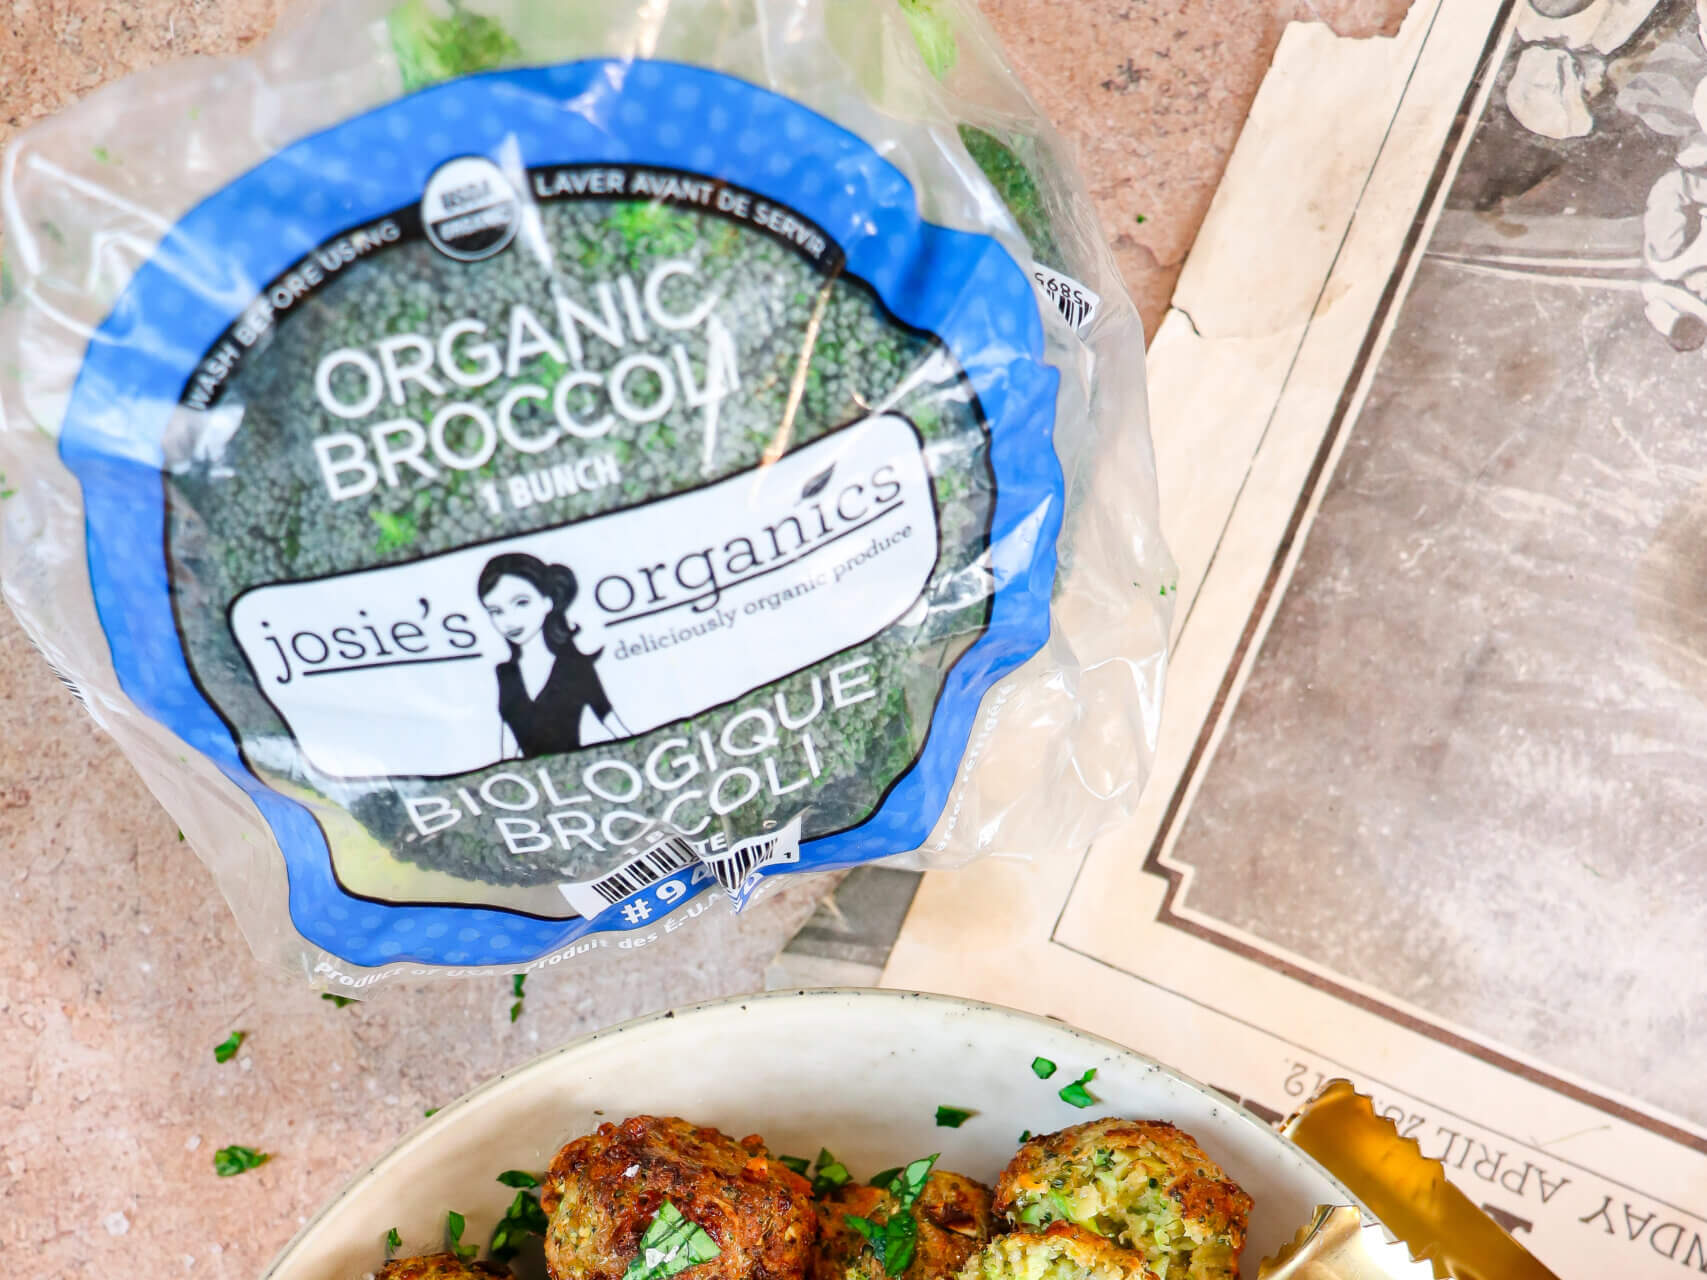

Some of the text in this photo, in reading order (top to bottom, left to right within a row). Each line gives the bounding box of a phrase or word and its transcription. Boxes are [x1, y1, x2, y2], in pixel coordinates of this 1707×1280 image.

[535, 168, 827, 260] LAVER AVANT DE SERVIR
[186, 341, 241, 412] WASH
[233, 263, 325, 347] BEFORE
[318, 218, 402, 273] USING
[314, 259, 720, 420] ORGANIC
[313, 327, 741, 503] BROCCOLI
[508, 452, 621, 510] BUNCH
[260, 462, 903, 685] josie's organics
[613, 524, 913, 661] deliciously organic produce
[405, 655, 877, 838] BIOLOGIQUE
[313, 961, 405, 989] Product
[617, 931, 659, 950] des
[1436, 1125, 1572, 1204] APRIL
